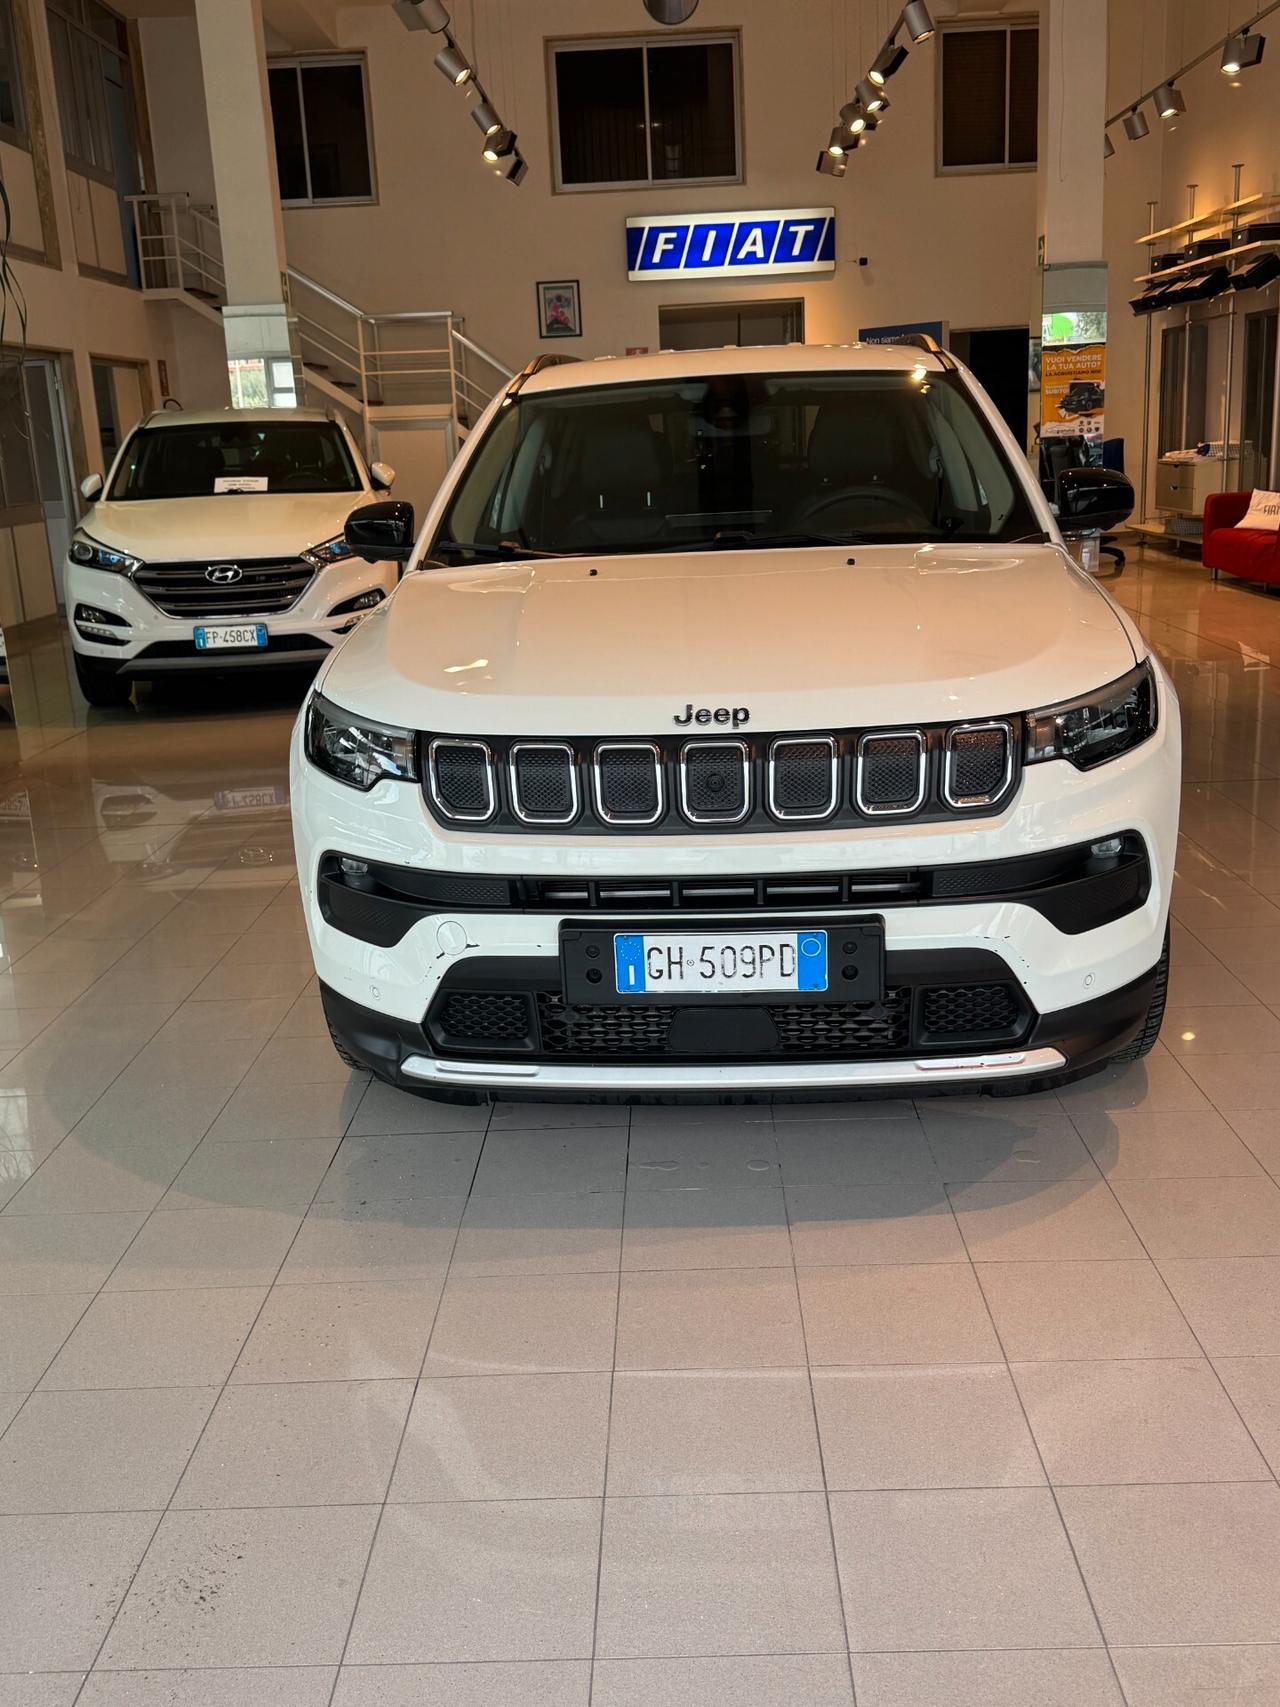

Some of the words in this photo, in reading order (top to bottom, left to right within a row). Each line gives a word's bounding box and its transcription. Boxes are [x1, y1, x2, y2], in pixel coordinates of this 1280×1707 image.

[651, 225, 815, 264] FIAT
[1067, 354, 1102, 362] VENDERE
[673, 704, 751, 729] Jeep
